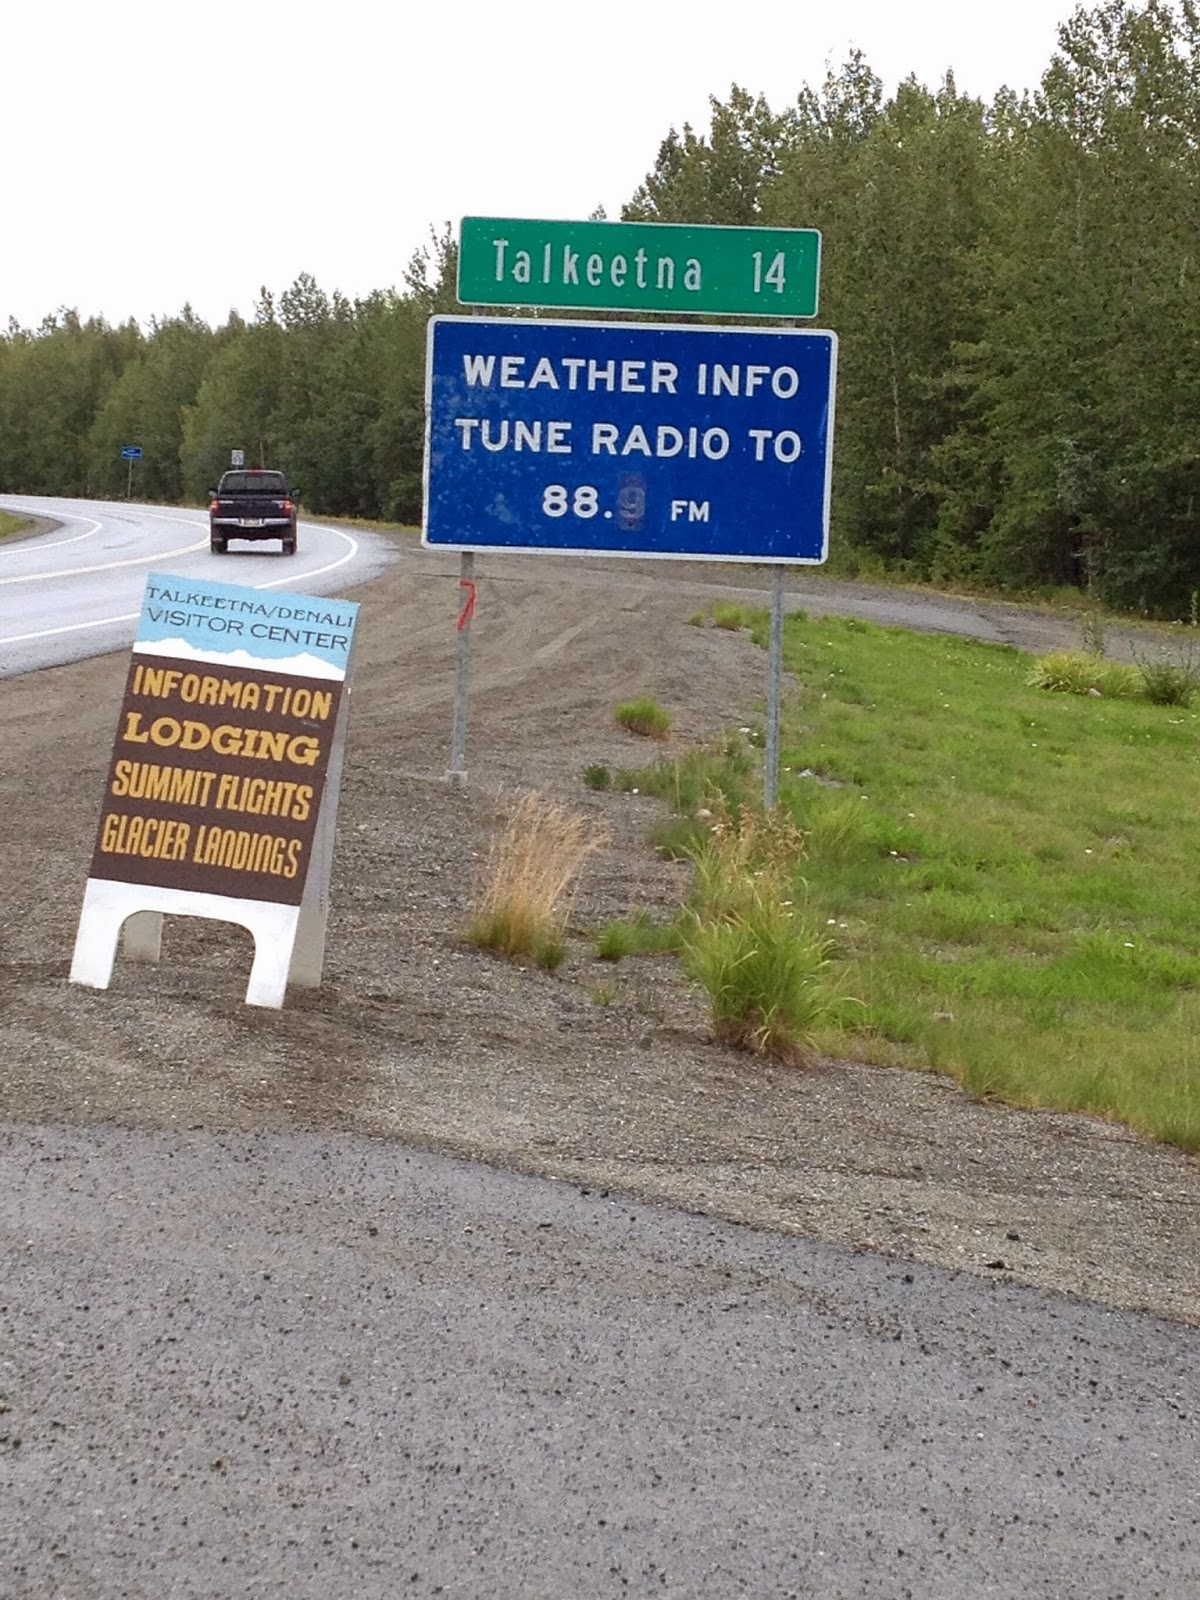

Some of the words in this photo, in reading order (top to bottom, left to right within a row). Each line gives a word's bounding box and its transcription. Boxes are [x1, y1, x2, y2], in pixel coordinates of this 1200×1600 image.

[493, 239, 701, 290] Talkeetna
[752, 251, 786, 293] 14
[463, 355, 679, 394] WEATHER
[698, 364, 800, 399] INFO
[455, 418, 572, 453] TUNE
[592, 423, 729, 460] RADIO
[749, 430, 801, 463] TO
[670, 500, 710, 522] FM
[147, 586, 354, 628] TALKEETNA/DENALI
[147, 608, 244, 637] VISITOR
[249, 625, 348, 652] CENTER
[133, 665, 332, 720] INFORMATION
[123, 712, 320, 766] LODGING
[112, 760, 216, 809] SUMMIT
[215, 773, 313, 822] FLIGHTS
[101, 813, 190, 862] GLACIER
[194, 825, 302, 879] LANDINGS
